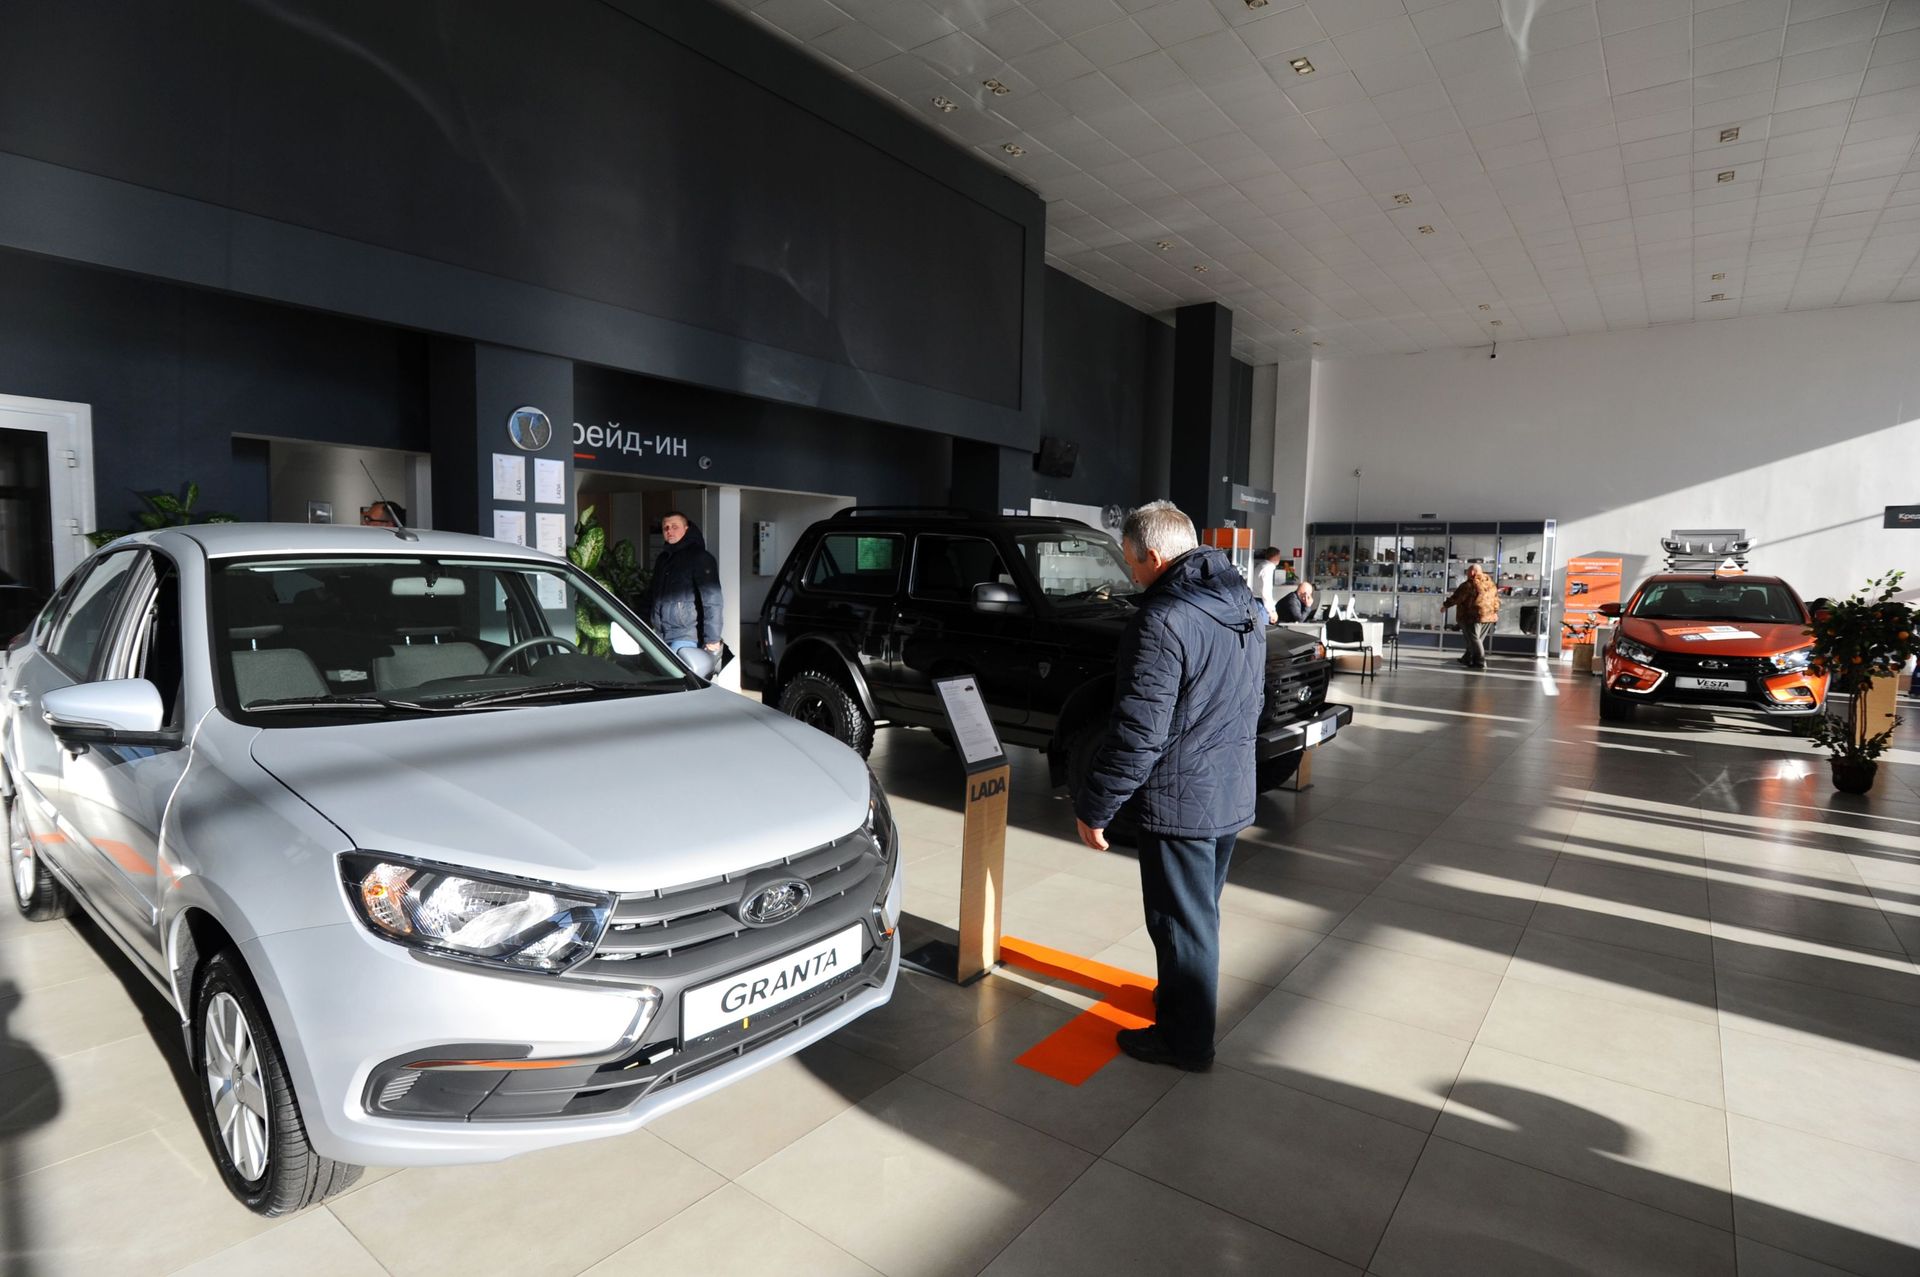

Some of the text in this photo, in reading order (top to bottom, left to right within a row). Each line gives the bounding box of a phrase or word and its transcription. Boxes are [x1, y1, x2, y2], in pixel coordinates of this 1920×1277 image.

[1696, 679, 1729, 688] VESTA
[970, 776, 1006, 802] LADA
[721, 947, 837, 1013] GRANTA
